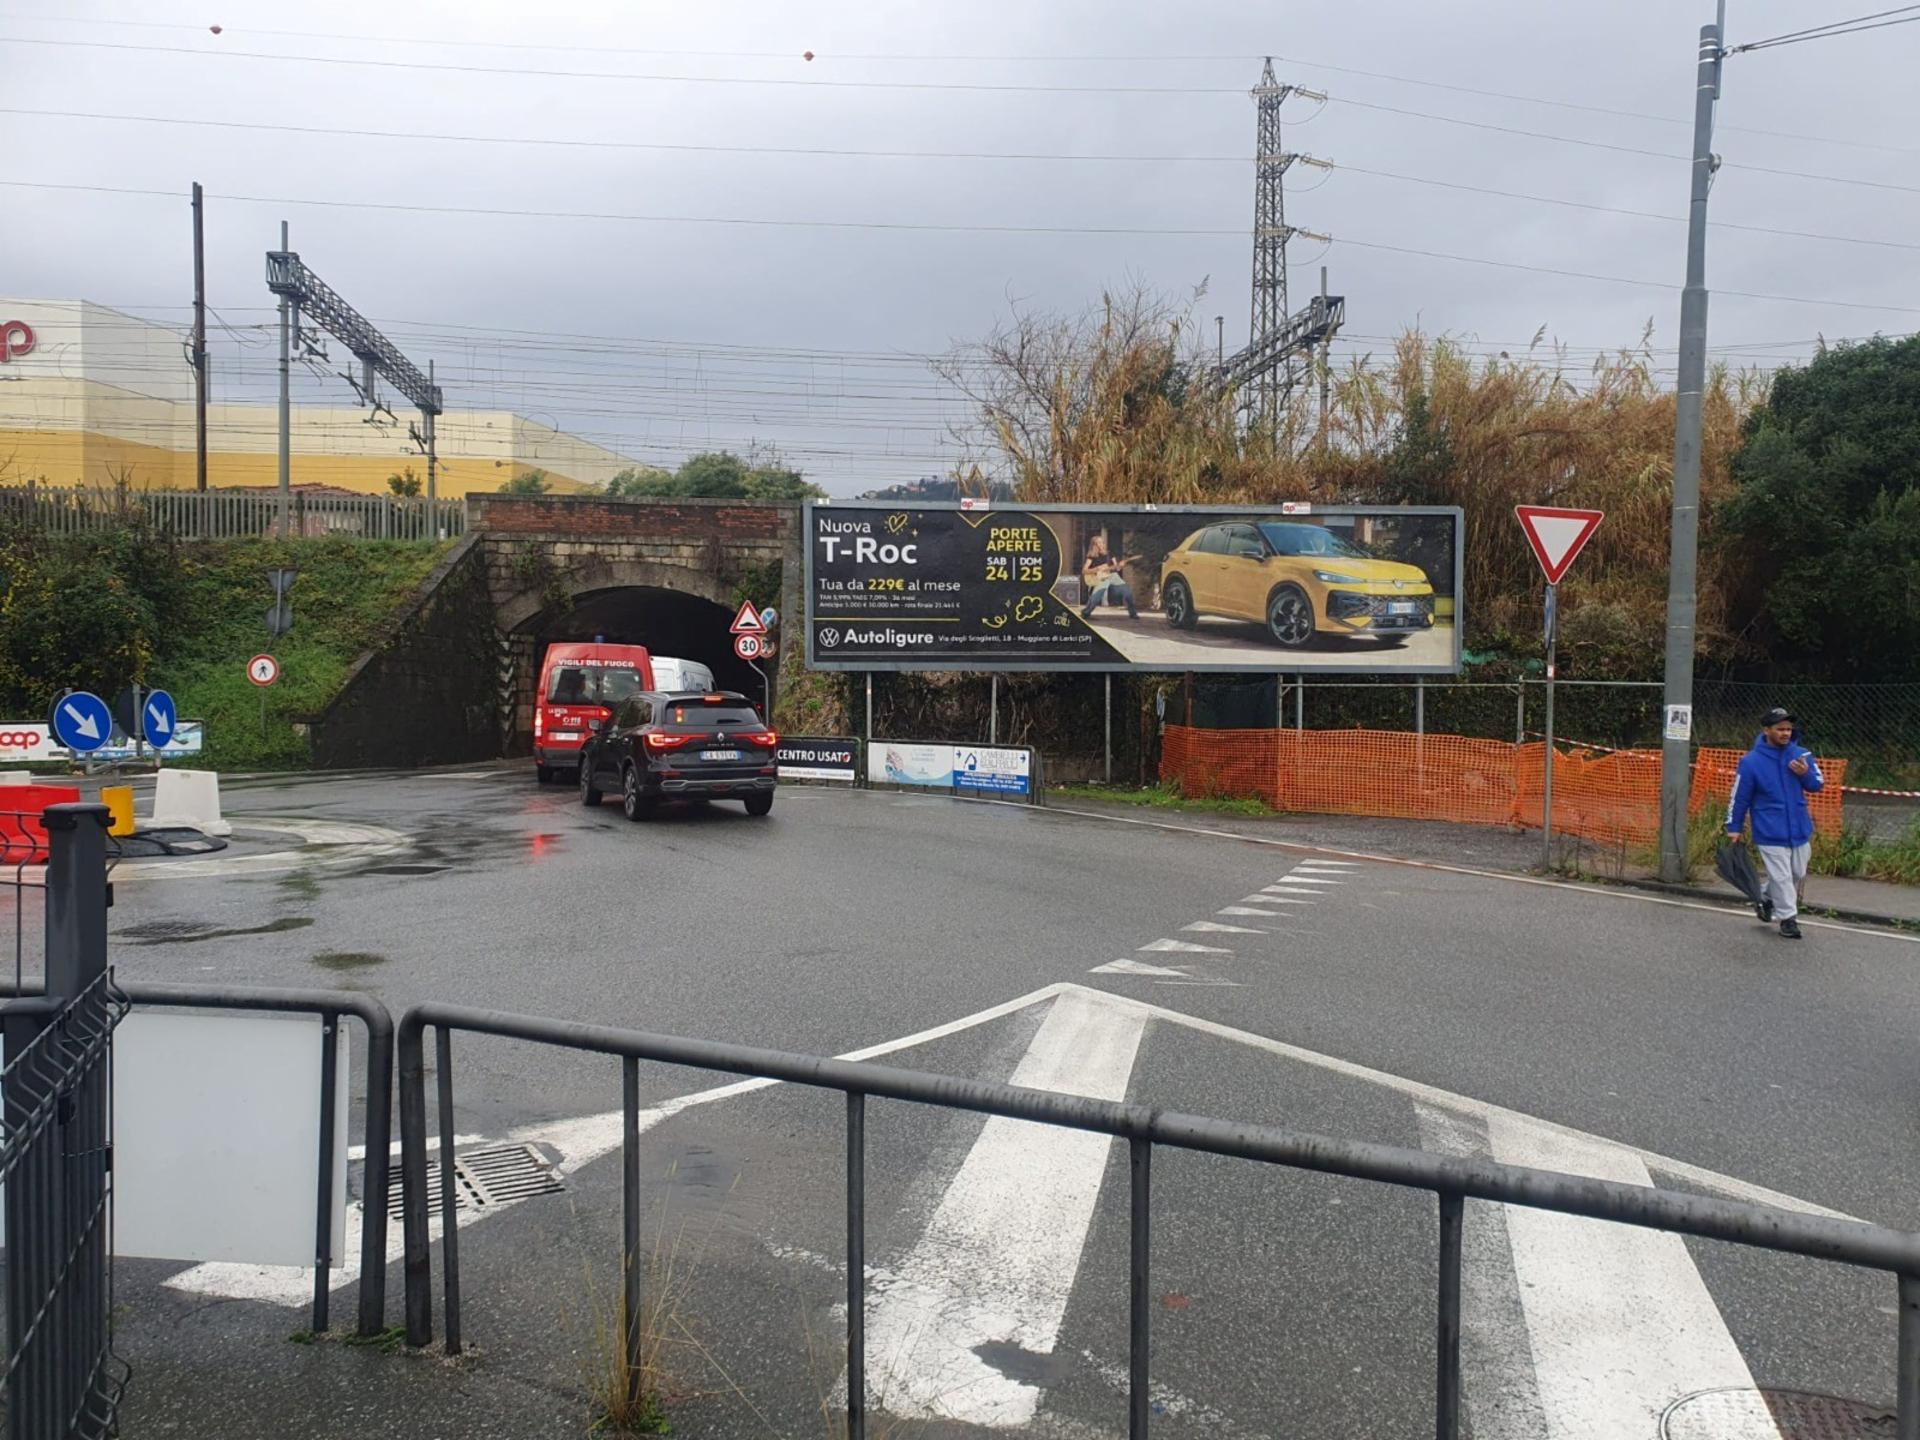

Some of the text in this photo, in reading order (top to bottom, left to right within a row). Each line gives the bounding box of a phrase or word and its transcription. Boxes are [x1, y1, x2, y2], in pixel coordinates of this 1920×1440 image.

[819, 518, 871, 533] Nuova
[990, 528, 1038, 540] PORTE
[819, 537, 918, 563] T-Roc
[986, 540, 1042, 552] APERTE
[986, 557, 1042, 566] SAB DOM
[985, 566, 1043, 581] 24 25
[819, 578, 961, 591] Tua da 229€ al mese
[844, 628, 934, 647] Autoligure
[950, 635, 967, 643] degli
[742, 640, 756, 652] 30
[604, 660, 635, 668] FUOCO
[0, 731, 40, 750] oop
[777, 749, 851, 763] CENTRO USATO
